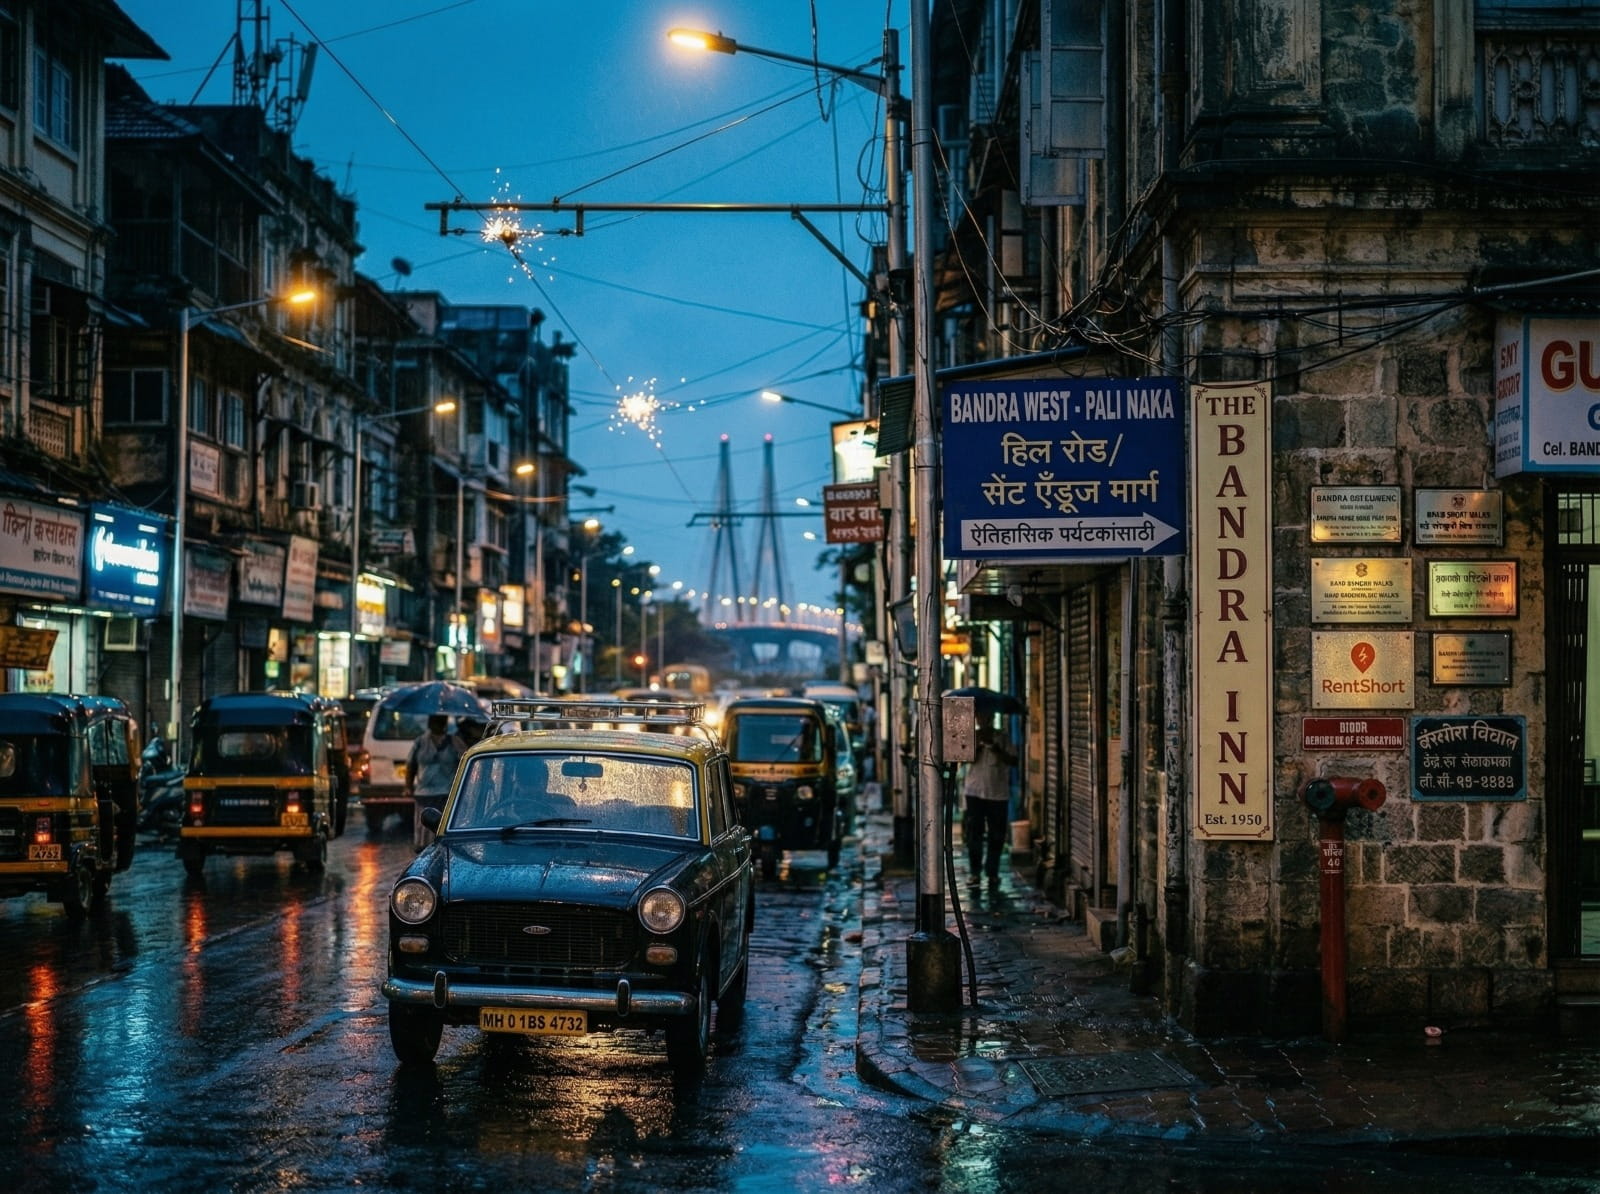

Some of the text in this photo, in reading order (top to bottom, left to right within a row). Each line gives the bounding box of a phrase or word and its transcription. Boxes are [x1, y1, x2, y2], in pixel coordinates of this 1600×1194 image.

[951, 392, 1020, 423] BANDRA
[1024, 391, 1071, 421] WEST
[1085, 390, 1121, 420] PALI
[1126, 388, 1175, 419] NAKA
[1206, 396, 1255, 416] THE
[1001, 430, 1123, 467] हिल रोड/
[1543, 441, 1566, 455] Cel.
[981, 473, 1027, 505] सेंट
[1109, 470, 1159, 503] मार्ग
[971, 521, 1155, 546] ऐतिहासिक पर्यटकांसाठी
[1216, 424, 1248, 805] BANDRA INN
[1322, 679, 1405, 693] RentShort
[1205, 814, 1262, 825] Est. 1950
[483, 1014, 504, 1027] MH
[550, 1016, 583, 1031] 4732
